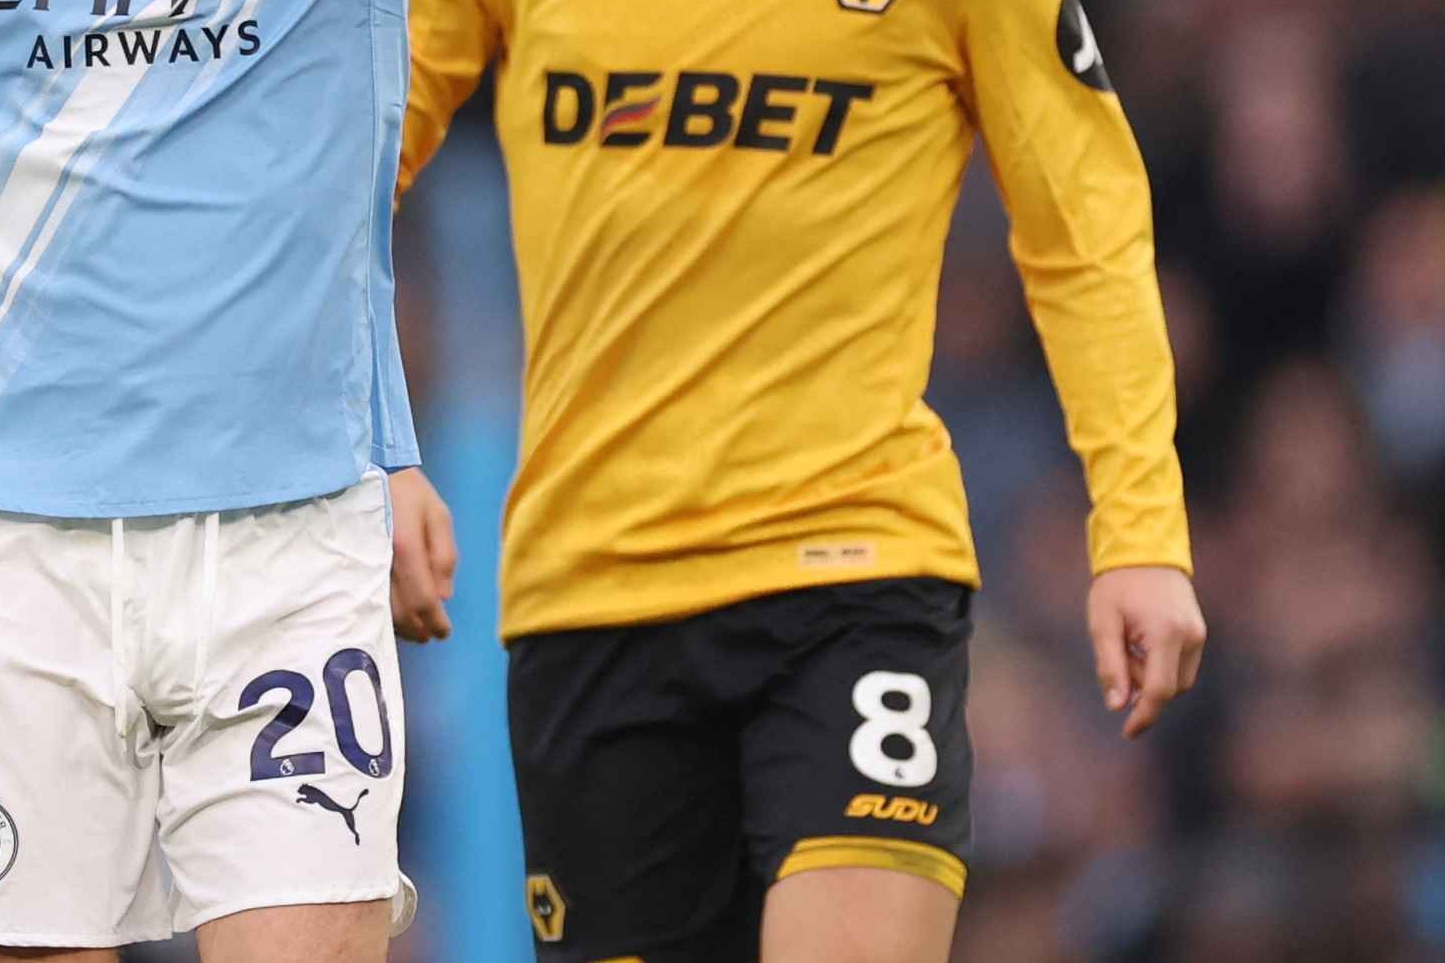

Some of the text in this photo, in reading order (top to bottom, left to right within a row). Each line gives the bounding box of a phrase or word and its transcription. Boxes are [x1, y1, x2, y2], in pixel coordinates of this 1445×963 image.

[26, 19, 262, 70] AIRWAYS
[543, 71, 874, 157] DEBET
[238, 647, 392, 782] 20
[848, 669, 939, 788] 8
[842, 793, 940, 826] SUDU
